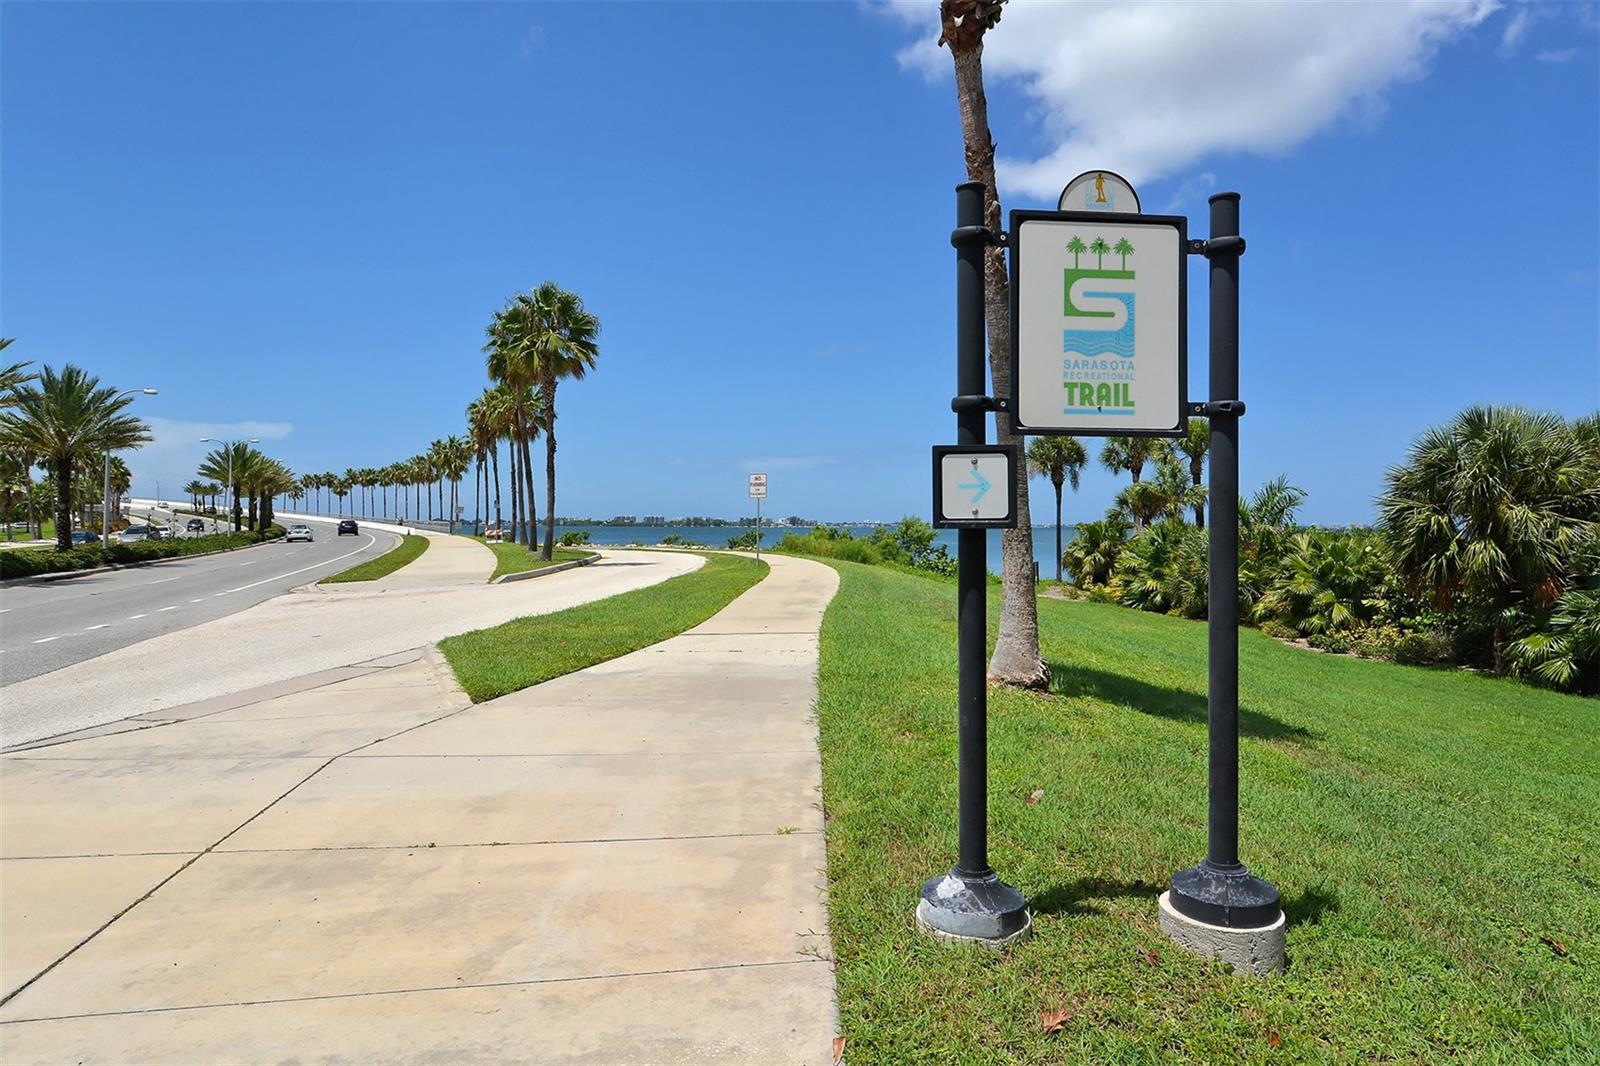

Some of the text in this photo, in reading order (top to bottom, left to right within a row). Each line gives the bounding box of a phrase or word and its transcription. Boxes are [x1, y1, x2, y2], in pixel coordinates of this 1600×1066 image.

[1063, 359, 1135, 370] SARASOTA
[1063, 371, 1136, 381] RECREATIONAL
[1063, 382, 1135, 407] TRAIL
